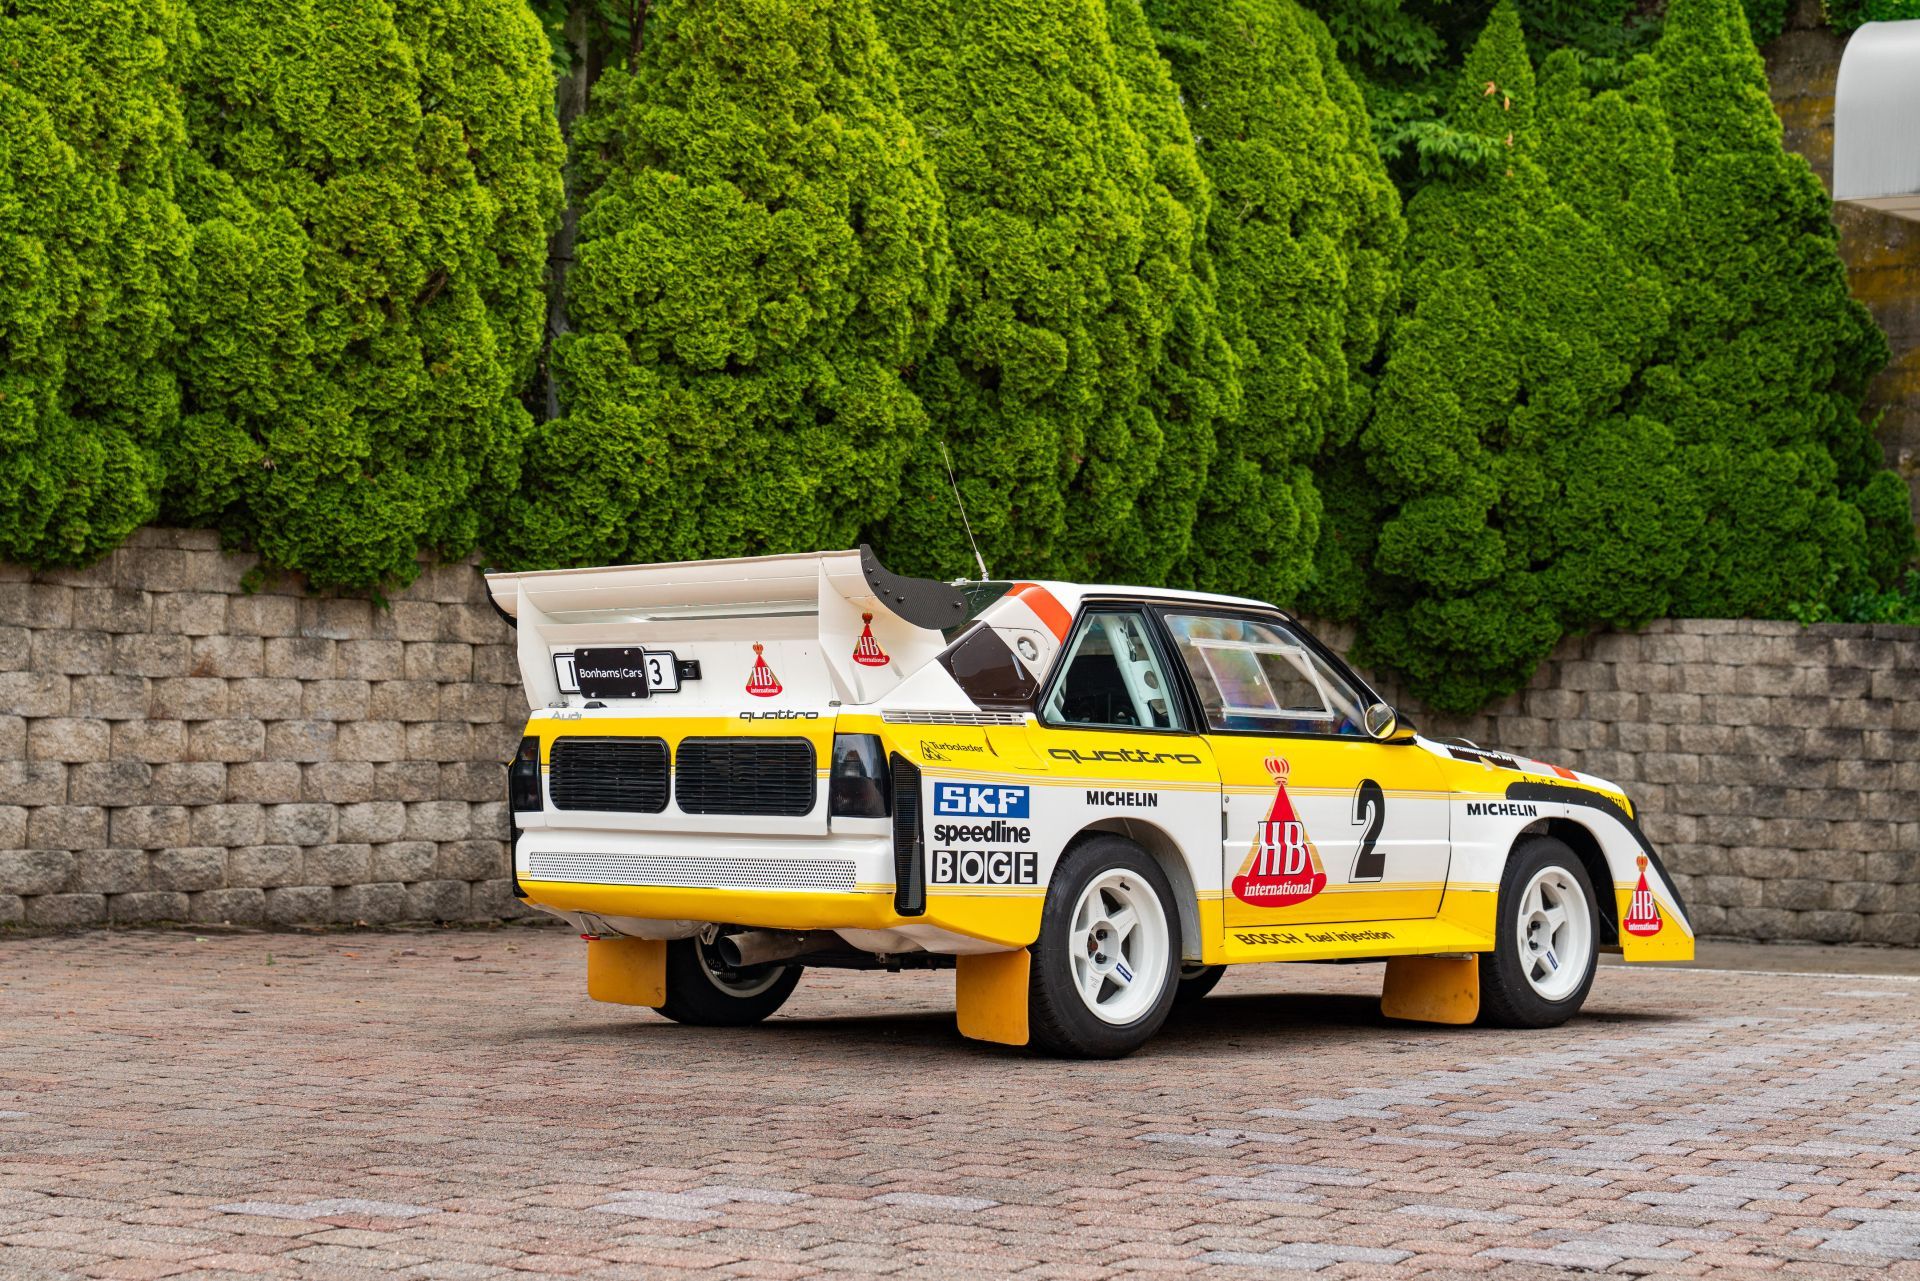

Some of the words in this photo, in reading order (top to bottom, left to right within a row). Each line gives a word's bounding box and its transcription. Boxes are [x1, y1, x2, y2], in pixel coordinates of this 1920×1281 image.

[857, 636, 880, 656] HB
[646, 658, 663, 686] 3
[752, 667, 773, 686] HB
[550, 710, 582, 721] Audi
[739, 709, 819, 722] quattro
[929, 742, 983, 753] Turbolader
[1048, 748, 1202, 764] quattro
[940, 786, 1025, 814] SKF
[1086, 790, 1158, 807] MICHELIN
[1467, 803, 1537, 817] MICHELIN
[934, 820, 1031, 846] speedline
[1348, 778, 1386, 883] 2
[1257, 820, 1307, 877] HB
[933, 850, 1037, 884] BOGE
[1243, 878, 1314, 897] international
[1632, 890, 1654, 920] HB
[1235, 933, 1303, 945] BOSCH
[1305, 931, 1334, 943] fuel
[1334, 929, 1395, 944] injection
